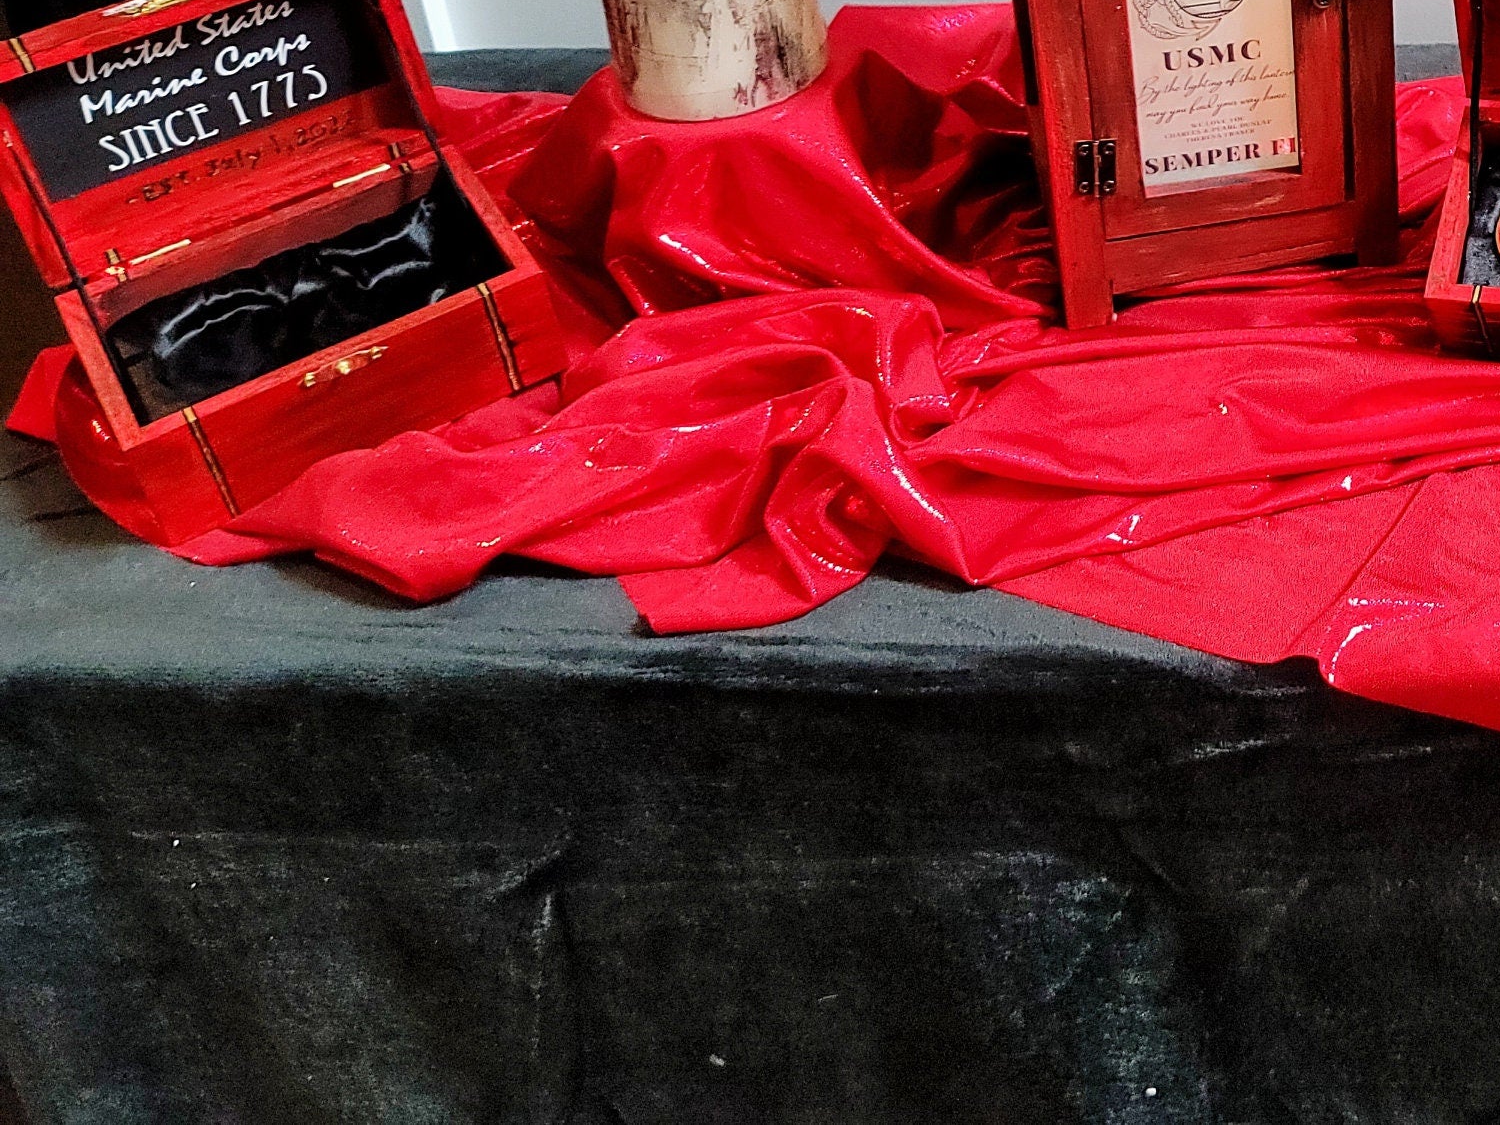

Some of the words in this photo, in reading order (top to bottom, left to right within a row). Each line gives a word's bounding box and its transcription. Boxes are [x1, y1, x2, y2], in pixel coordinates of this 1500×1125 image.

[67, 26, 189, 85] United
[196, 1, 294, 46] States
[79, 68, 208, 124] Marine
[214, 33, 312, 76] Corps
[1162, 39, 1262, 72] USMC
[98, 103, 220, 172] SINCE
[227, 64, 329, 126] 1775
[1144, 142, 1262, 175] SEMPER
[1271, 137, 1297, 156] FI
